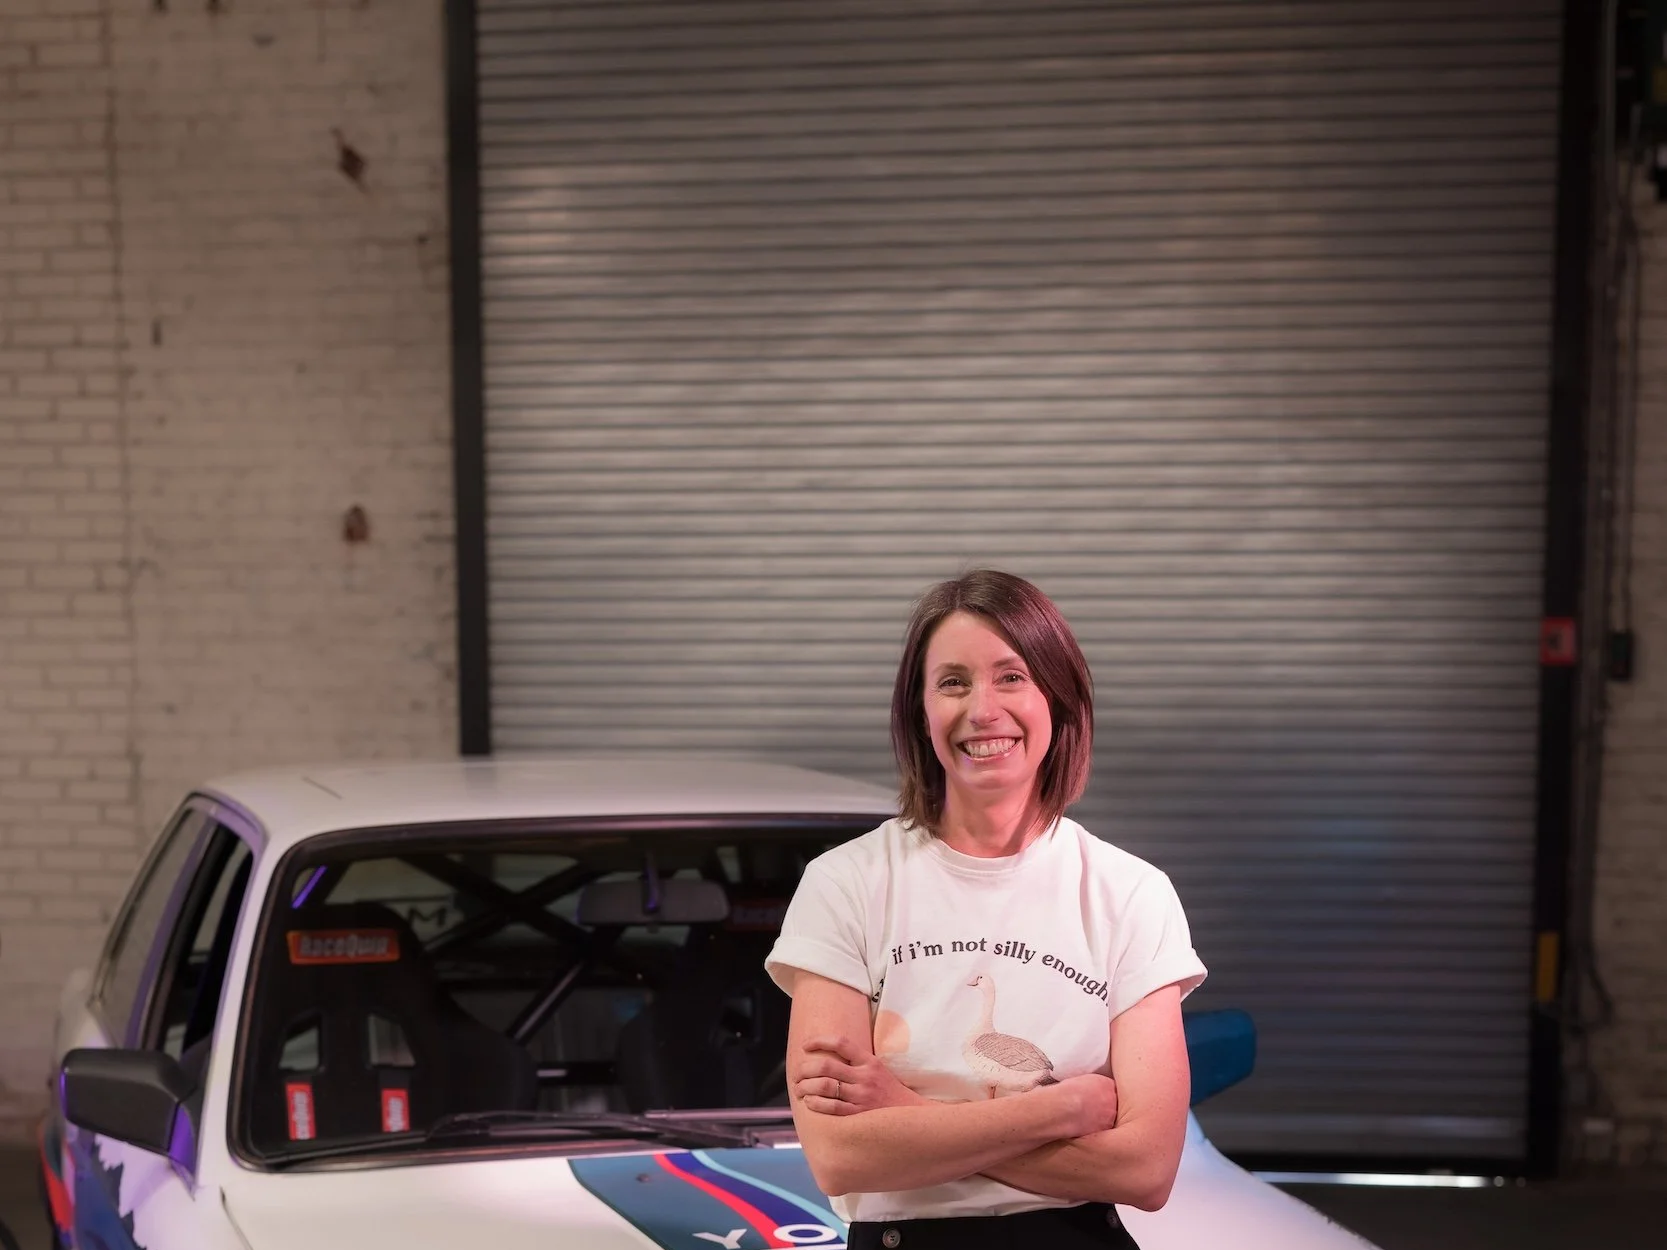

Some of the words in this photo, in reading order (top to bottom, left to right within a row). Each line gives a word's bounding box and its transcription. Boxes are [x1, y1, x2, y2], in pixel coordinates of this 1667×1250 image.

[891, 944, 903, 965] if
[908, 941, 943, 960] i'm
[951, 937, 987, 952] not
[993, 940, 1037, 964] silly
[692, 1223, 848, 1250] YO
